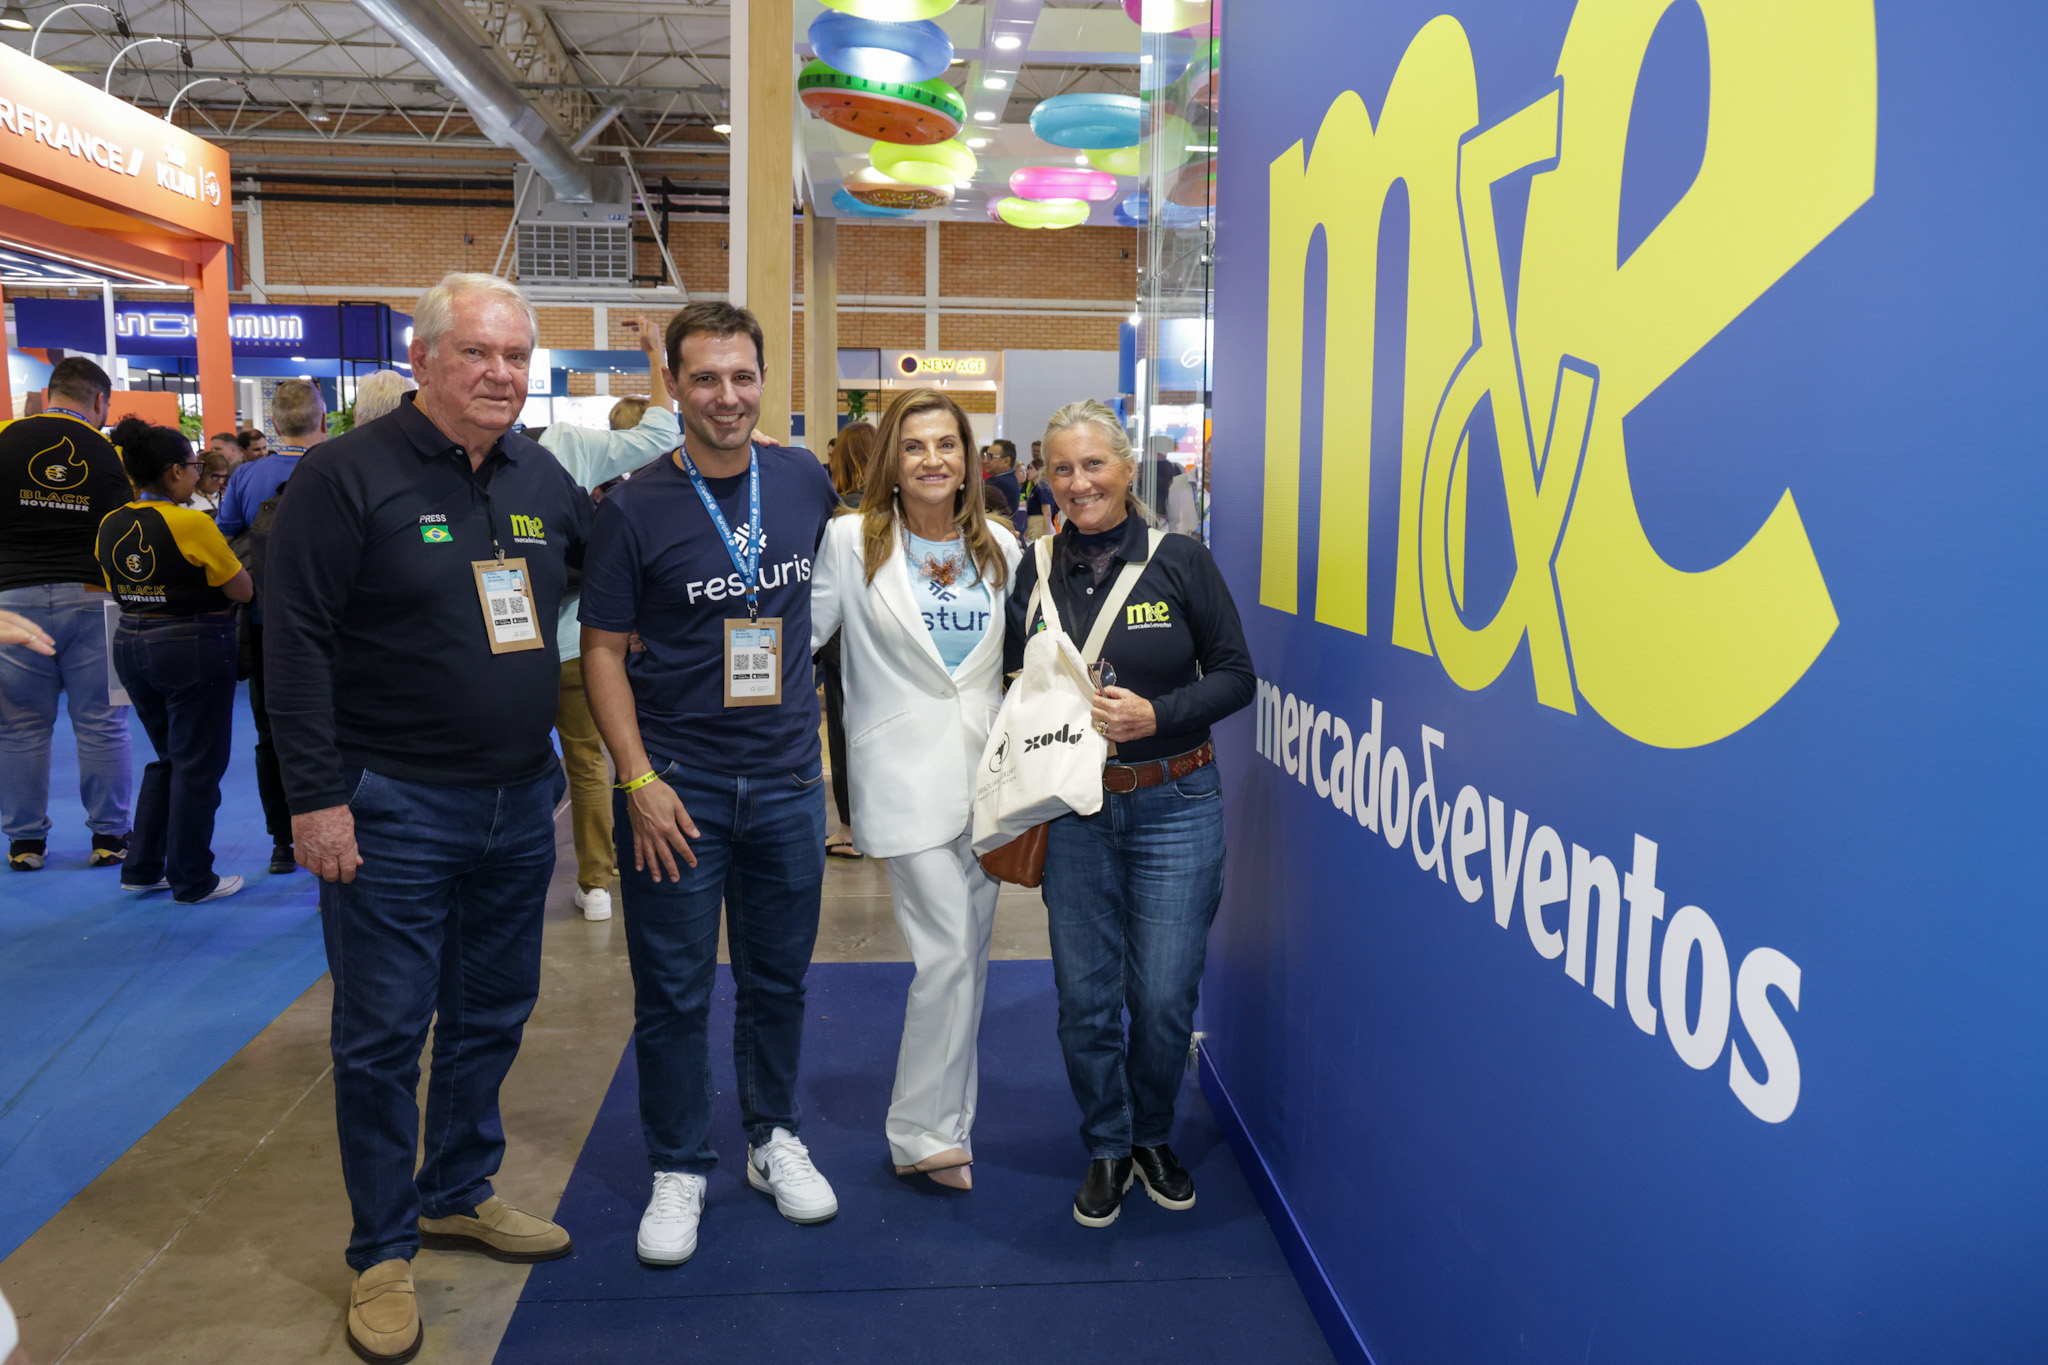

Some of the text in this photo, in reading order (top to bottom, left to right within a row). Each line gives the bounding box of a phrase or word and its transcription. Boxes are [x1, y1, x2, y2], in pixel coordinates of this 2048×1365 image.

[156, 161, 196, 199] KLM
[114, 312, 303, 340] incmum
[922, 359, 985, 372] NEW AGE
[1259, 0, 1877, 749] m&e
[20, 489, 91, 505] BLACK
[20, 498, 90, 512] NOVEMBER
[419, 513, 447, 523] PRESS
[117, 584, 166, 596] BLACK
[120, 594, 167, 603] NOVEMBER
[1126, 601, 1170, 624] m&e
[1256, 677, 1802, 1124] mercado&eventos
